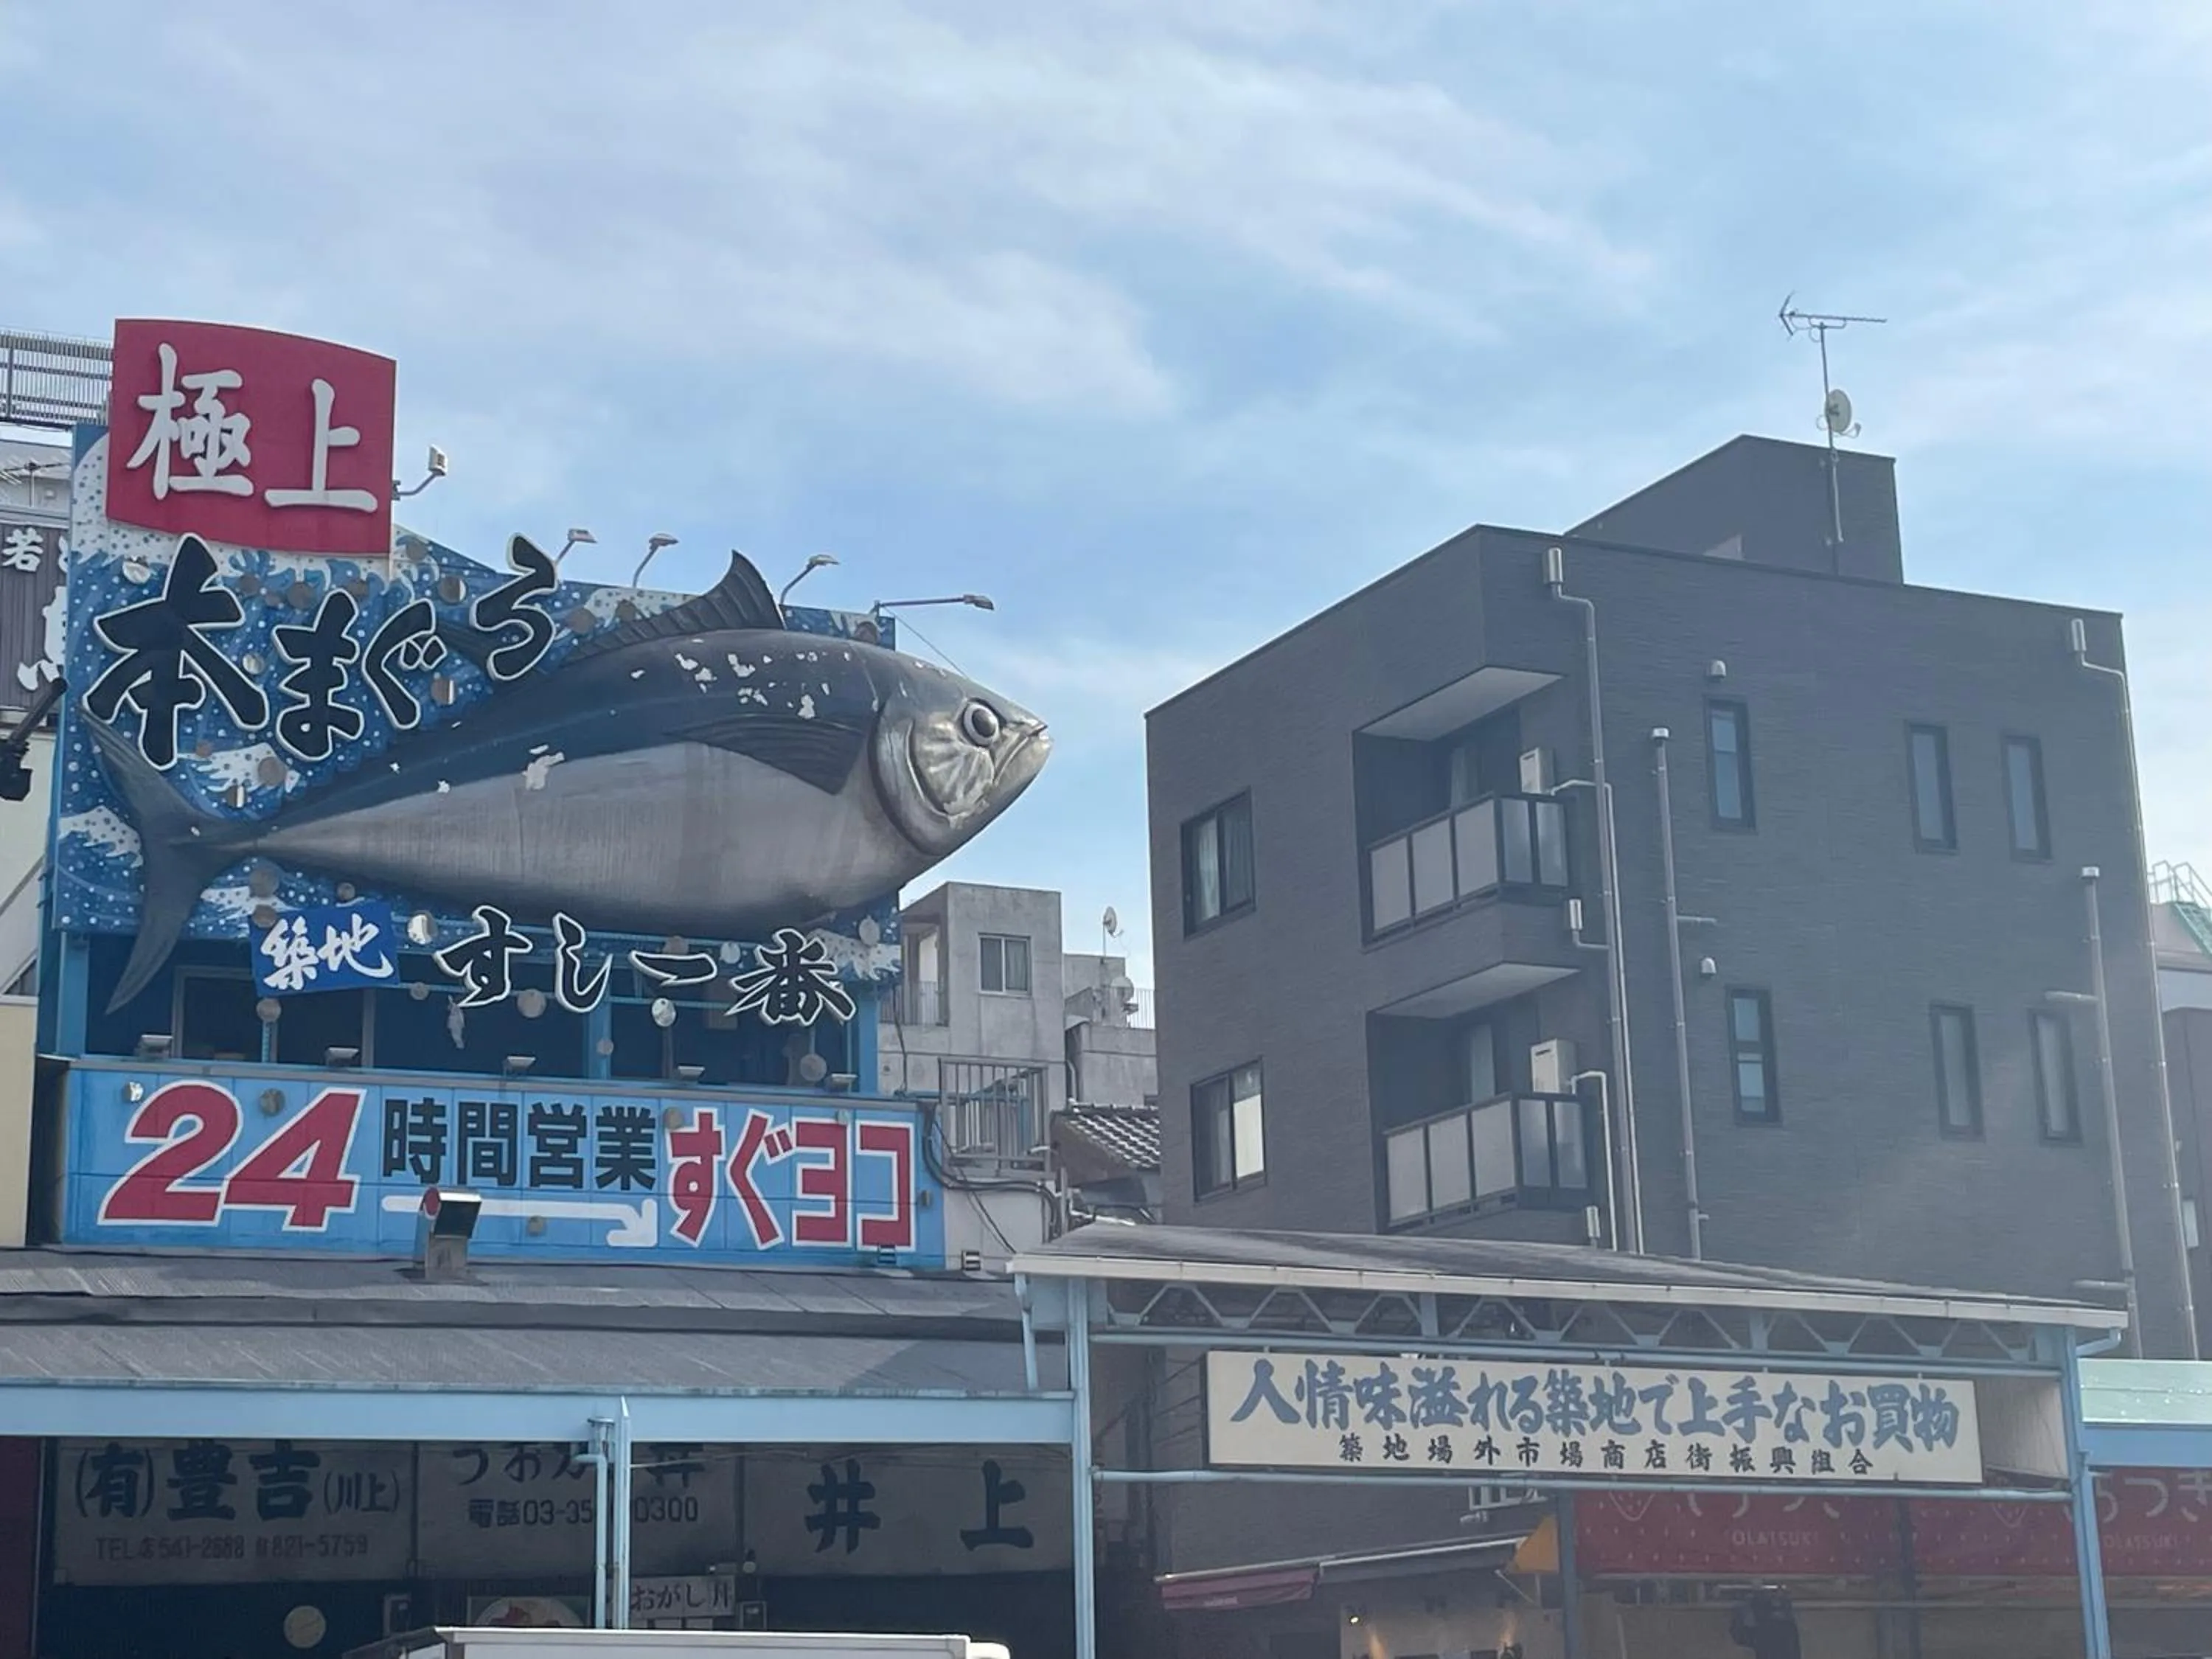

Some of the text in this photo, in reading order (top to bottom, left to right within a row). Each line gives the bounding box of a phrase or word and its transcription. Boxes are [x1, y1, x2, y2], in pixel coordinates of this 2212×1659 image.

[127, 343, 378, 512] 極上
[83, 533, 557, 771] 本まぐろ
[260, 913, 394, 990] 築地
[434, 905, 856, 1026] すし一番
[1230, 1358, 1961, 1452] 人情味溢れる築地で上手なお買物
[1340, 1434, 1874, 1475] 築地場外市場商店街振興組合
